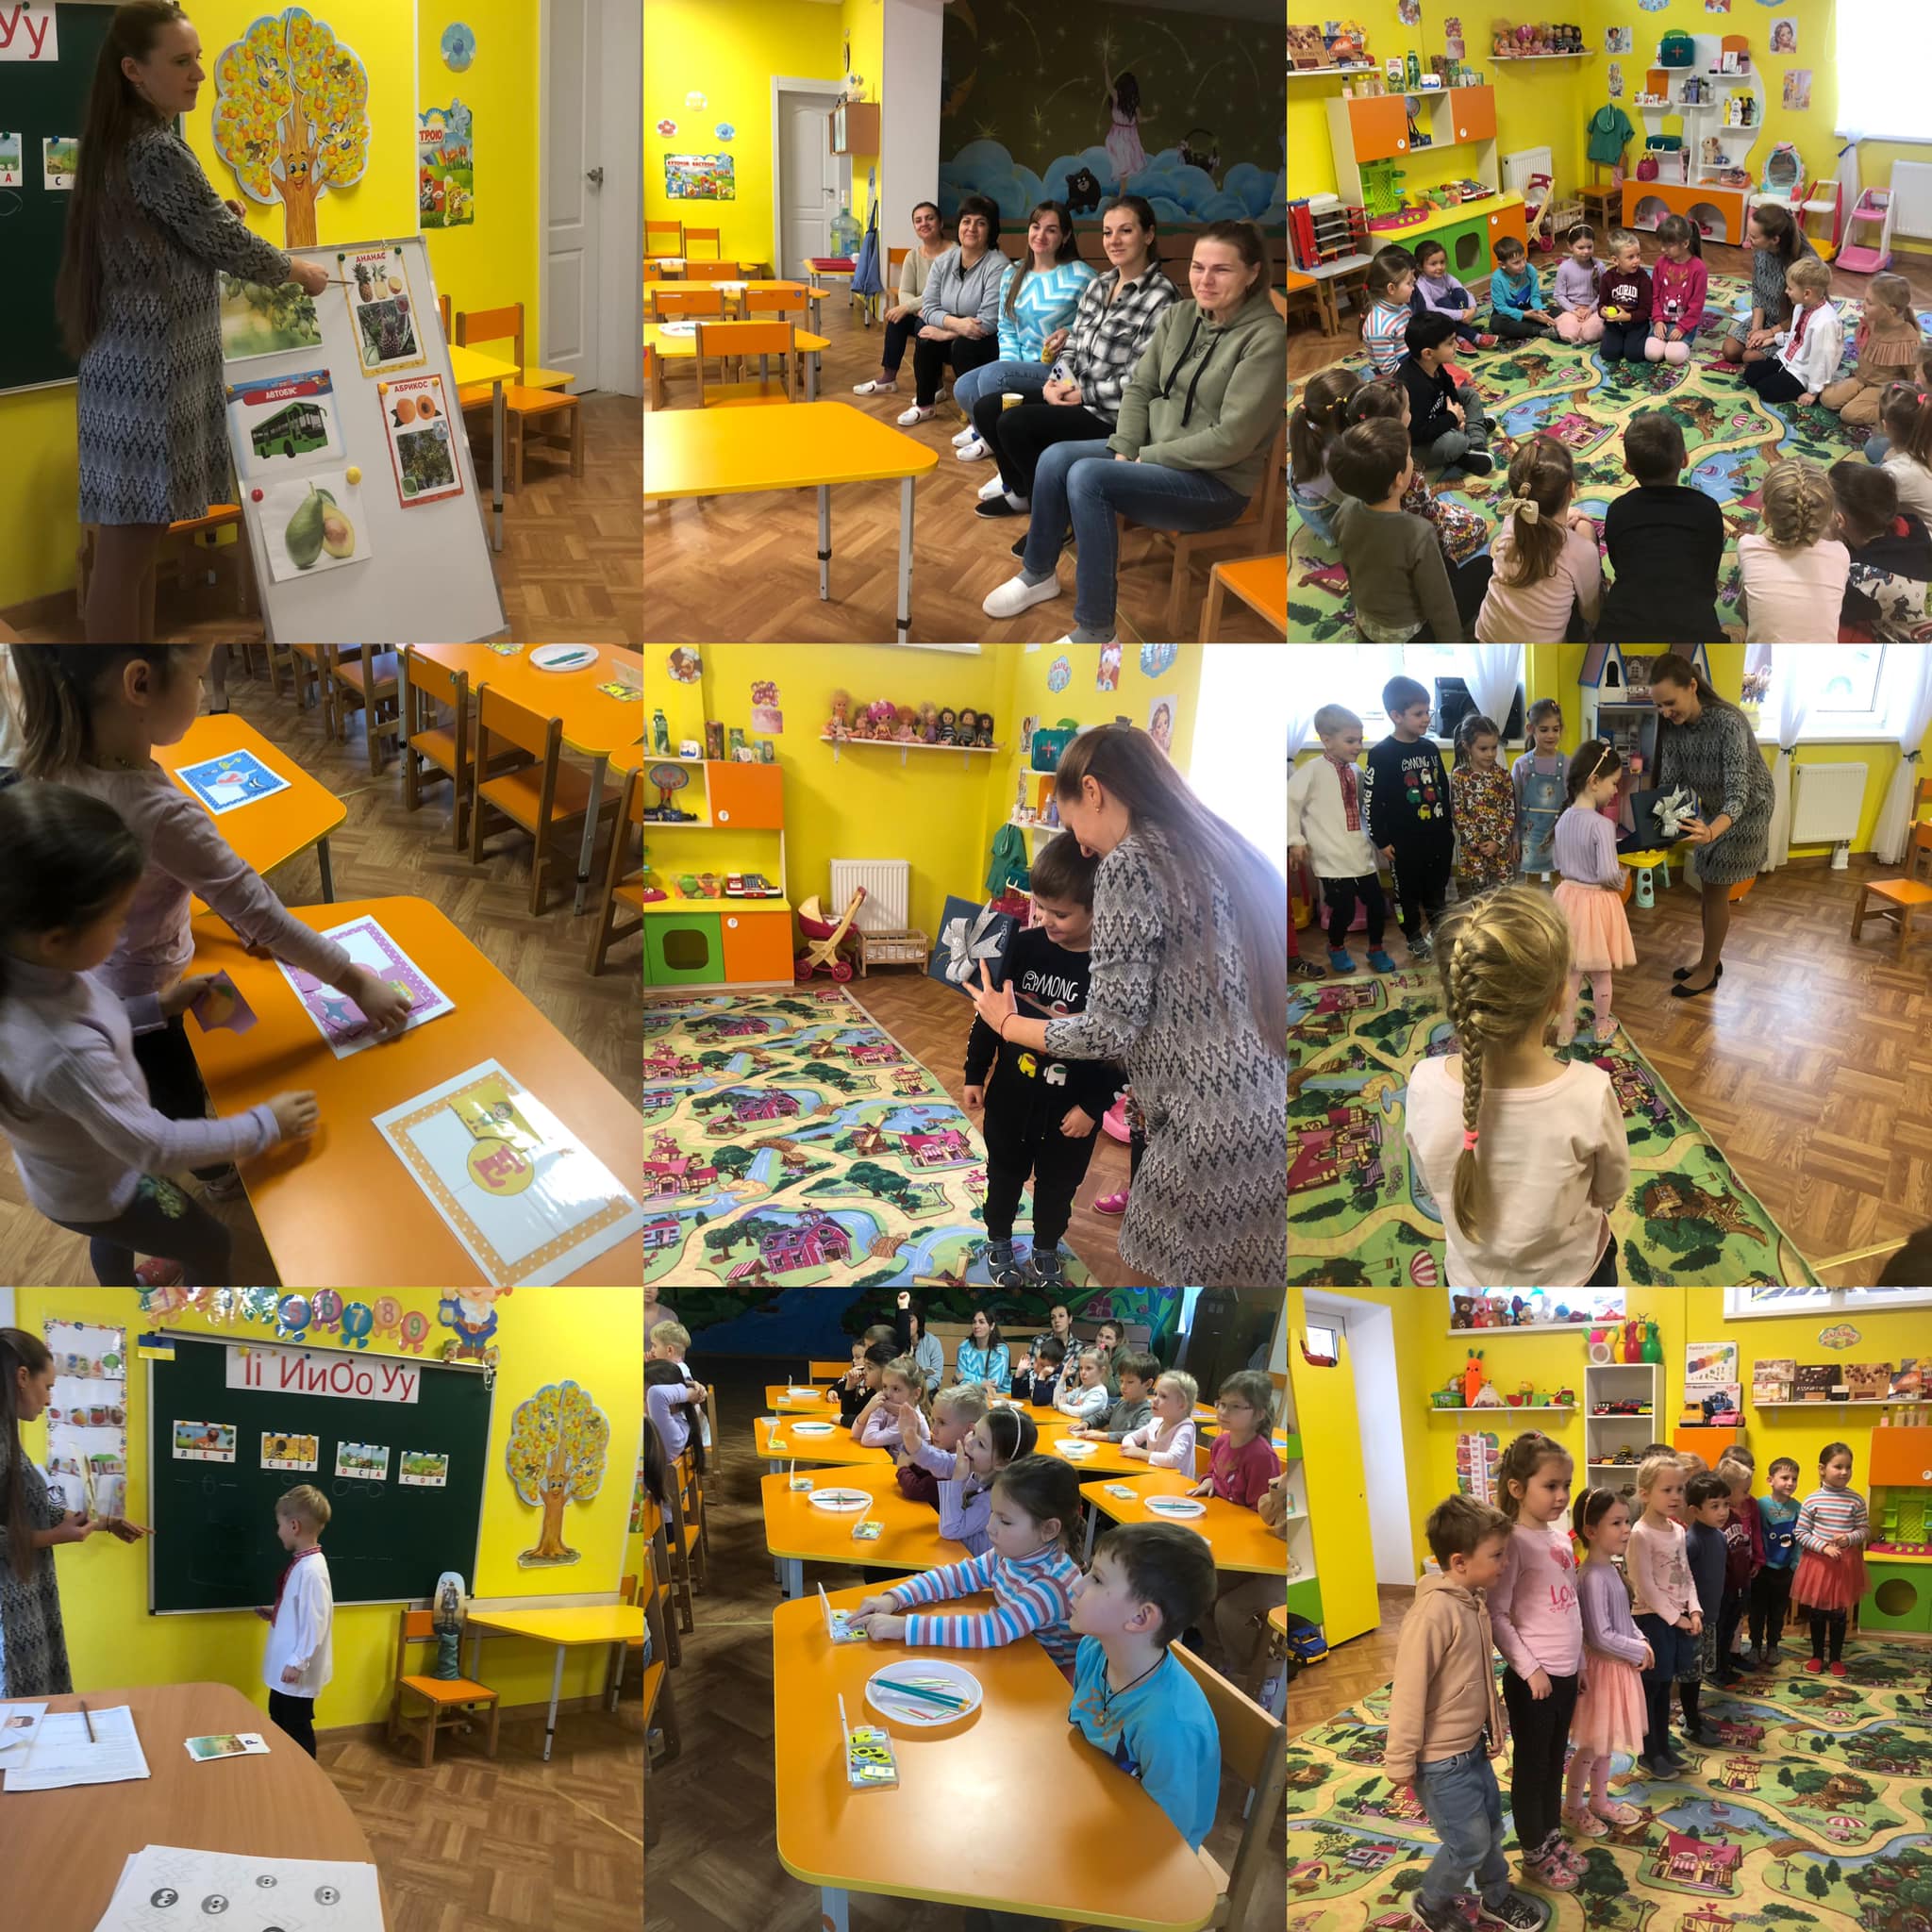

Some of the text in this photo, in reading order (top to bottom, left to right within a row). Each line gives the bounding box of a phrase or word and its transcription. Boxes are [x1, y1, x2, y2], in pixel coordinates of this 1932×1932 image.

[419, 129, 443, 142] ТРОЮ
[5, 174, 12, 182] А
[55, 176, 61, 186] С
[356, 252, 387, 263] АНАНАС
[265, 387, 298, 400] АВТОБУС
[393, 380, 428, 392] АБРИКОС
[288, 1301, 303, 1323] 5
[322, 1295, 333, 1315] 6
[383, 1302, 393, 1321] 8
[351, 1308, 364, 1331] 7
[409, 1317, 421, 1337] 9
[381, 1364, 415, 1402] Уу
